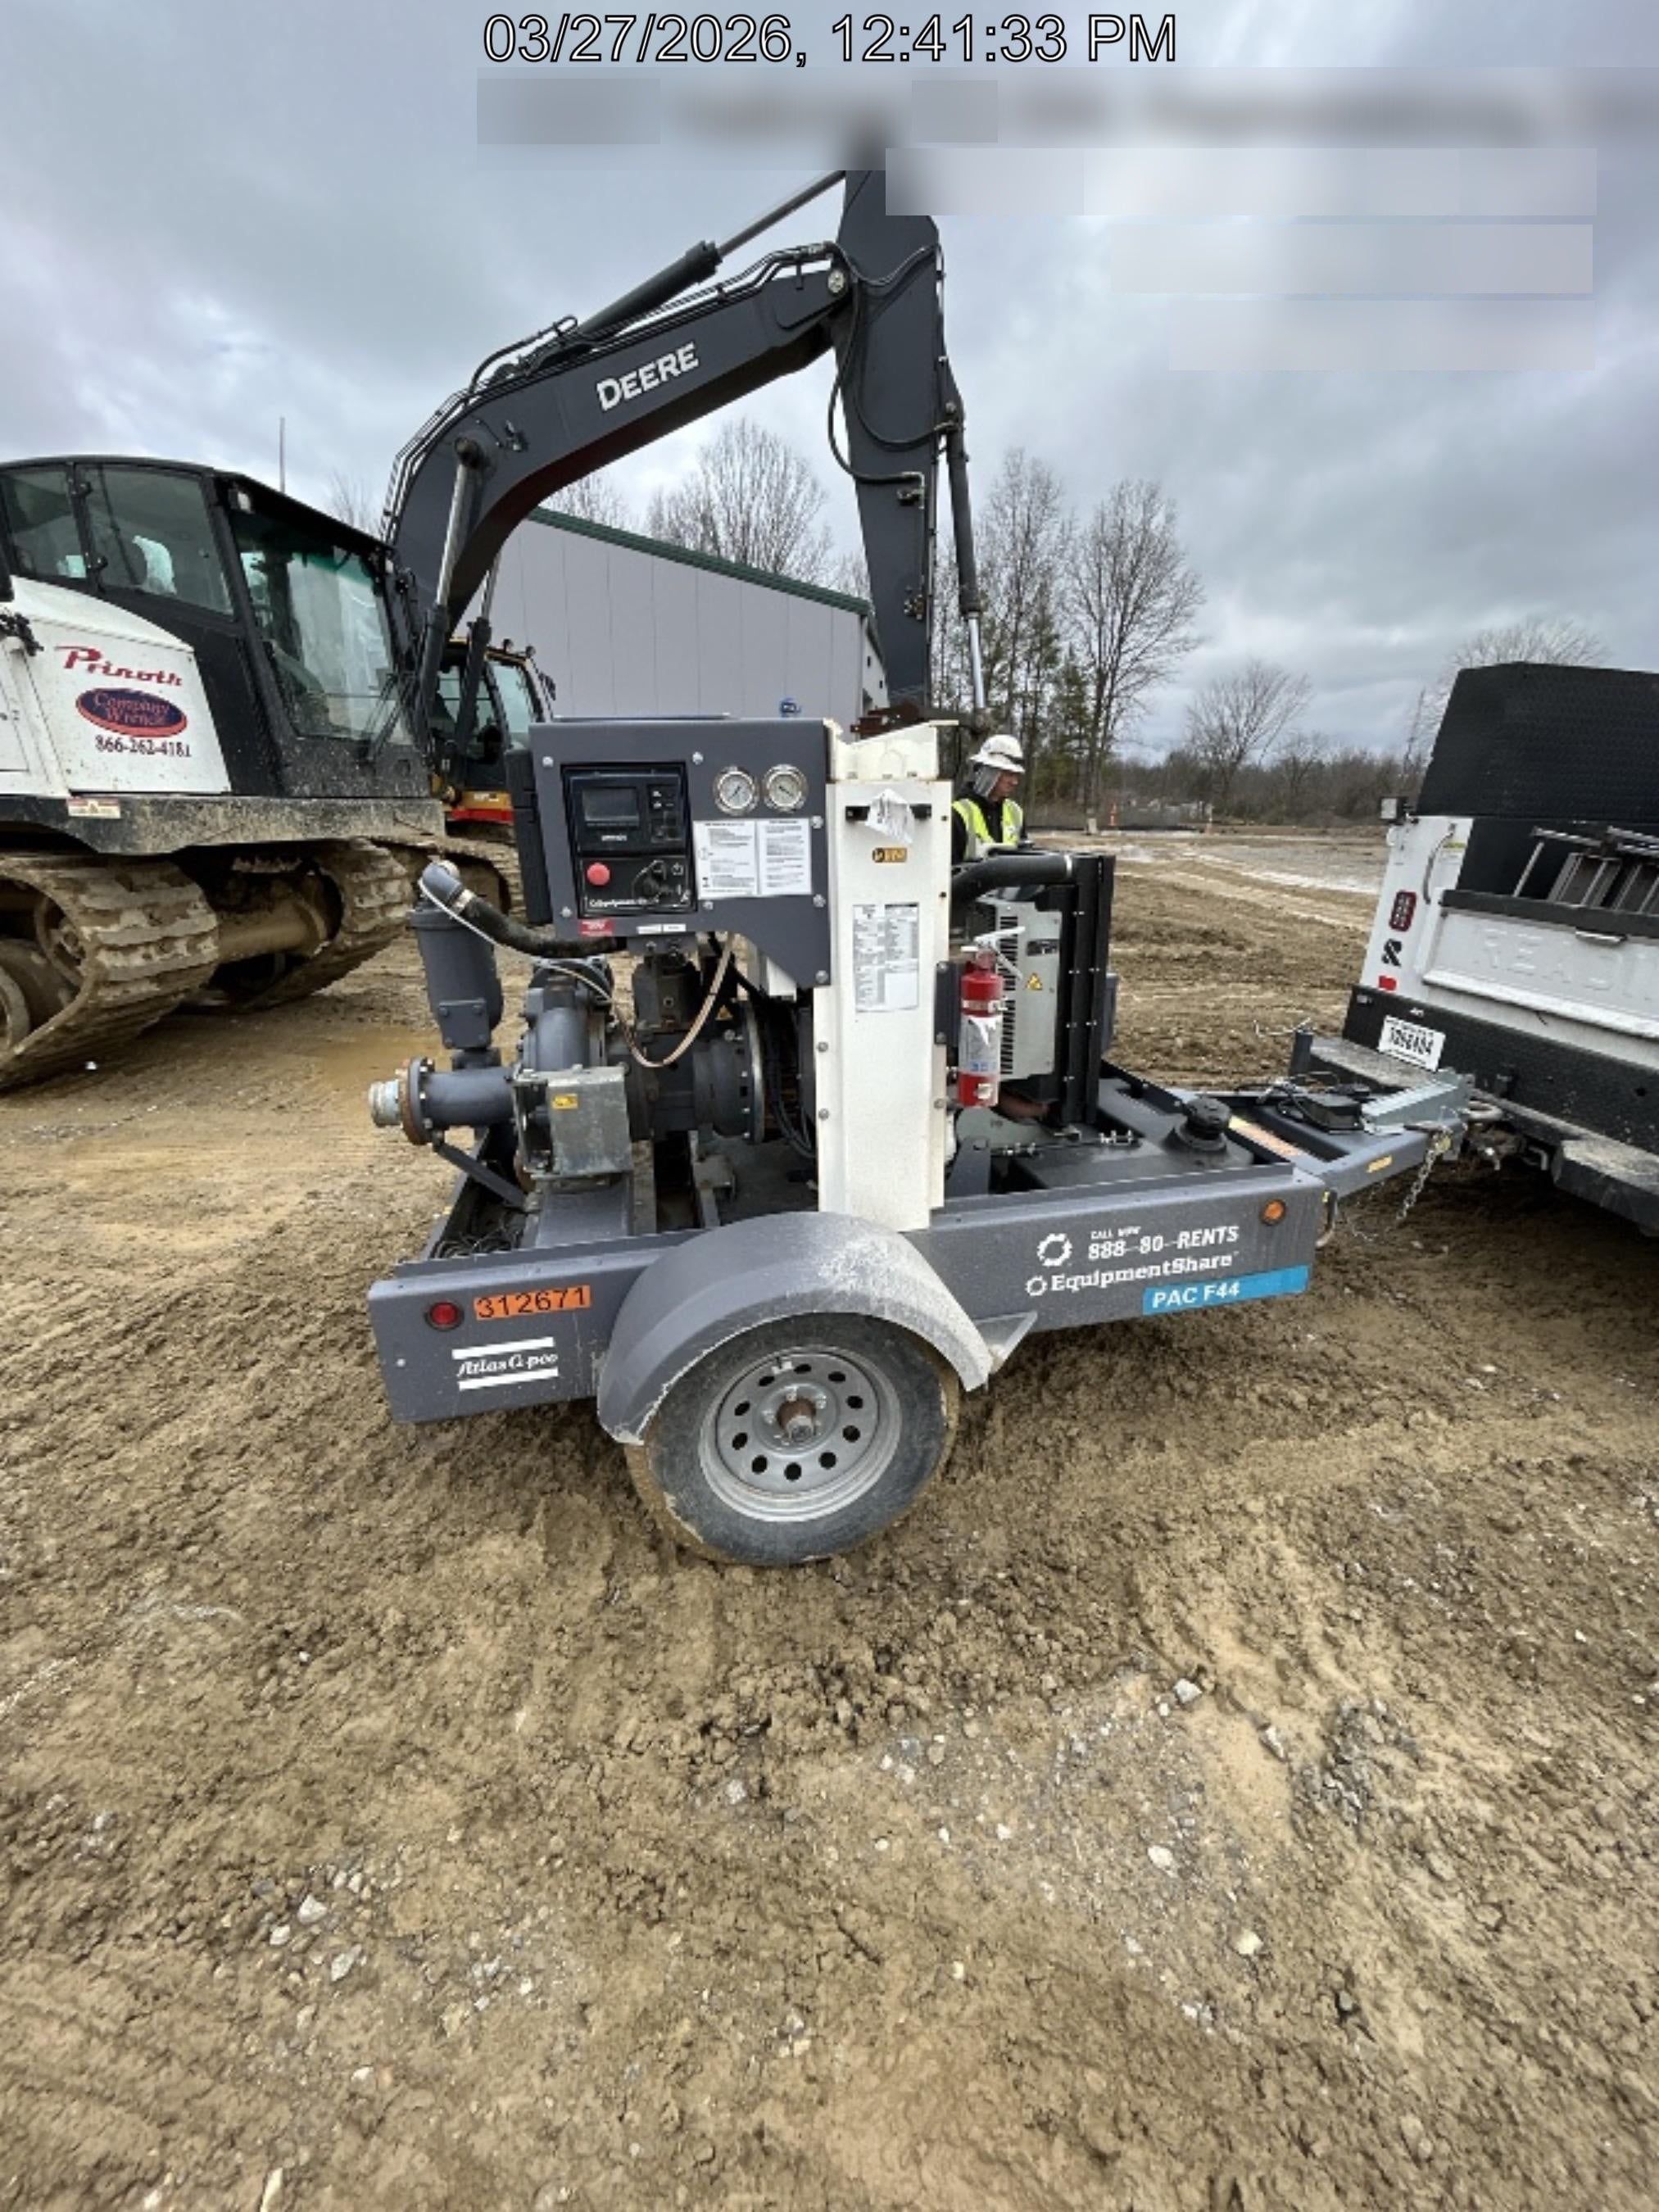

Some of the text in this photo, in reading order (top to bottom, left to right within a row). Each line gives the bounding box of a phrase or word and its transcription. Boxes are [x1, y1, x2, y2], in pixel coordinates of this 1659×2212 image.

[596, 341, 699, 410] DEERE
[54, 645, 183, 686] Prinoth
[1051, 1255, 1232, 1292] EquipmentShare
[477, 1287, 585, 1317] 312671
[1153, 1281, 1240, 1308] PAC F44
[456, 1359, 507, 1376] Atlas
